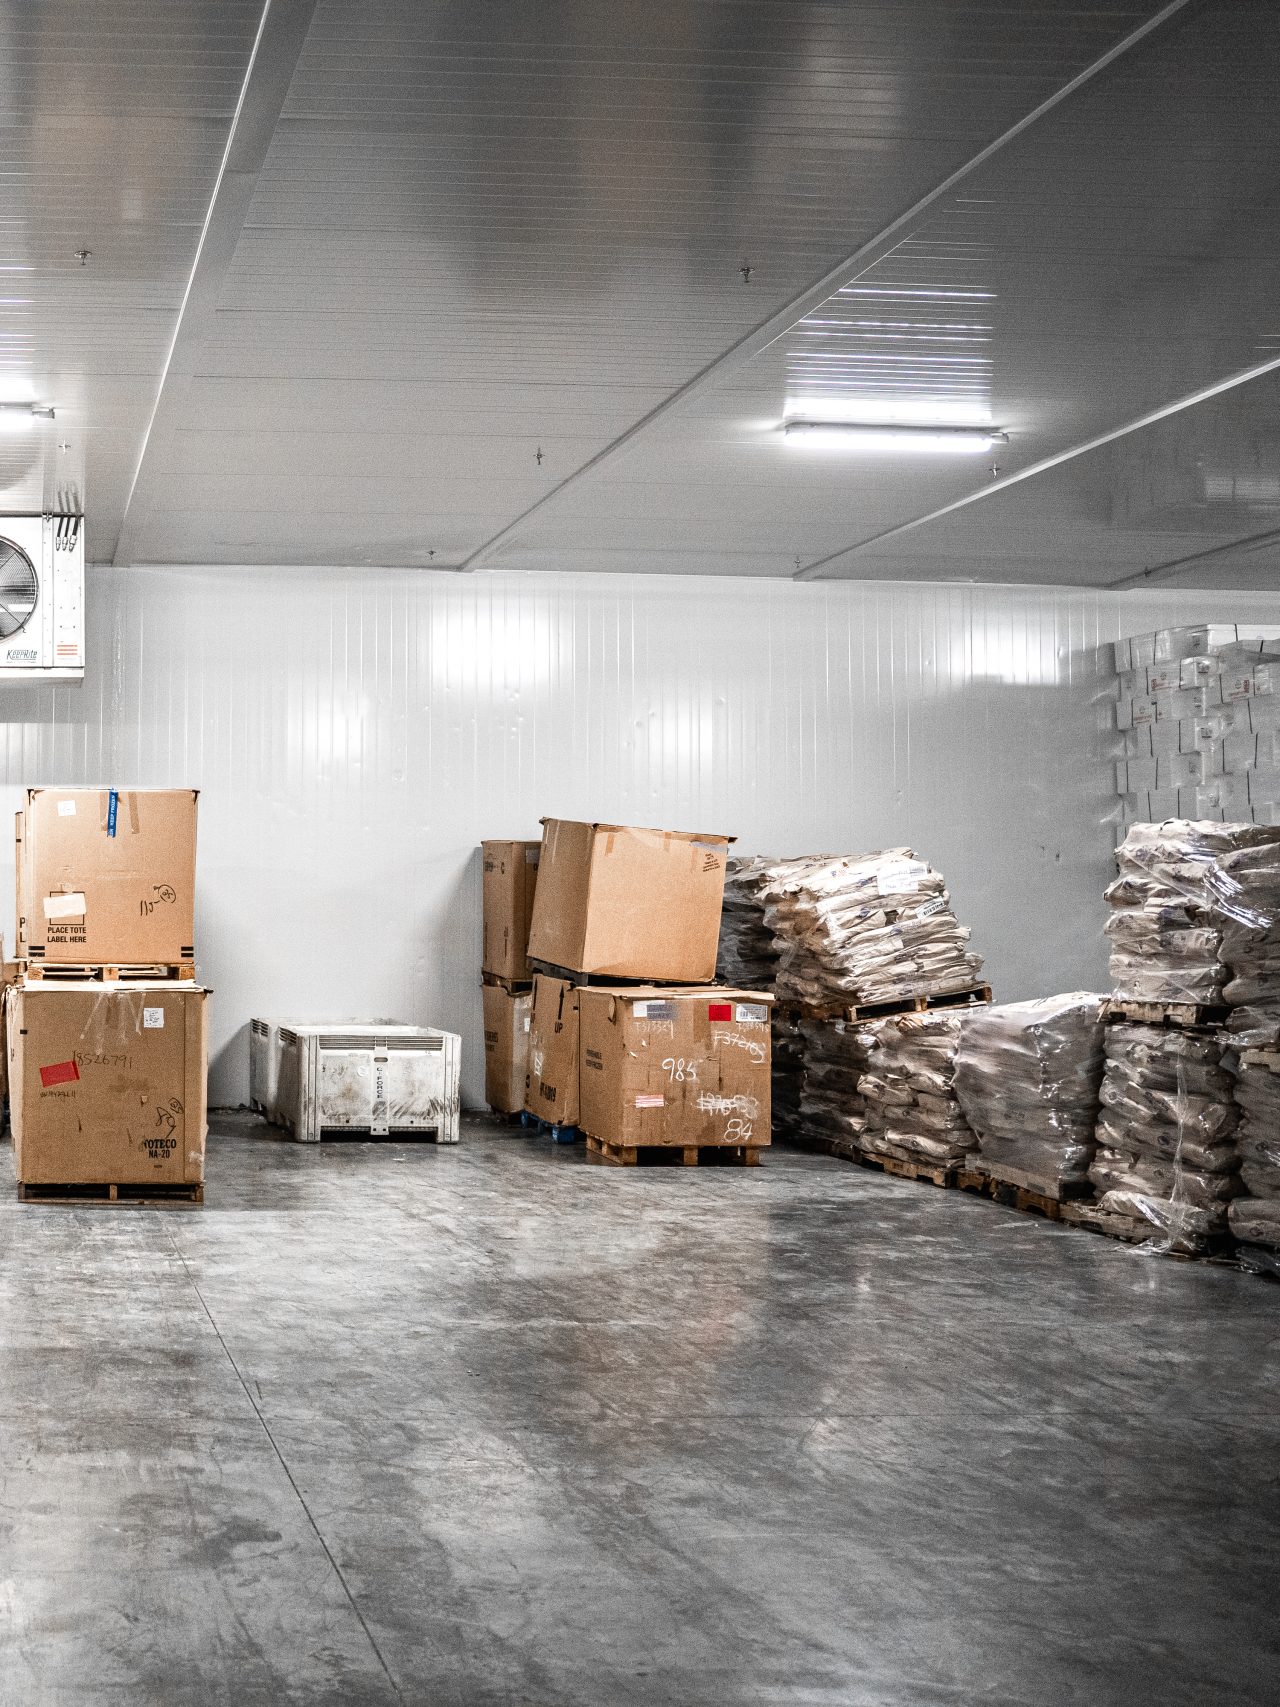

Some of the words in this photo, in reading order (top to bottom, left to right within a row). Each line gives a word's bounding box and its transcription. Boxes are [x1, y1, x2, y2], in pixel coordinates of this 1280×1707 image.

[662, 1057, 697, 1083] 985
[724, 1119, 752, 1141] 84
[149, 1150, 170, 1158] NA-20
